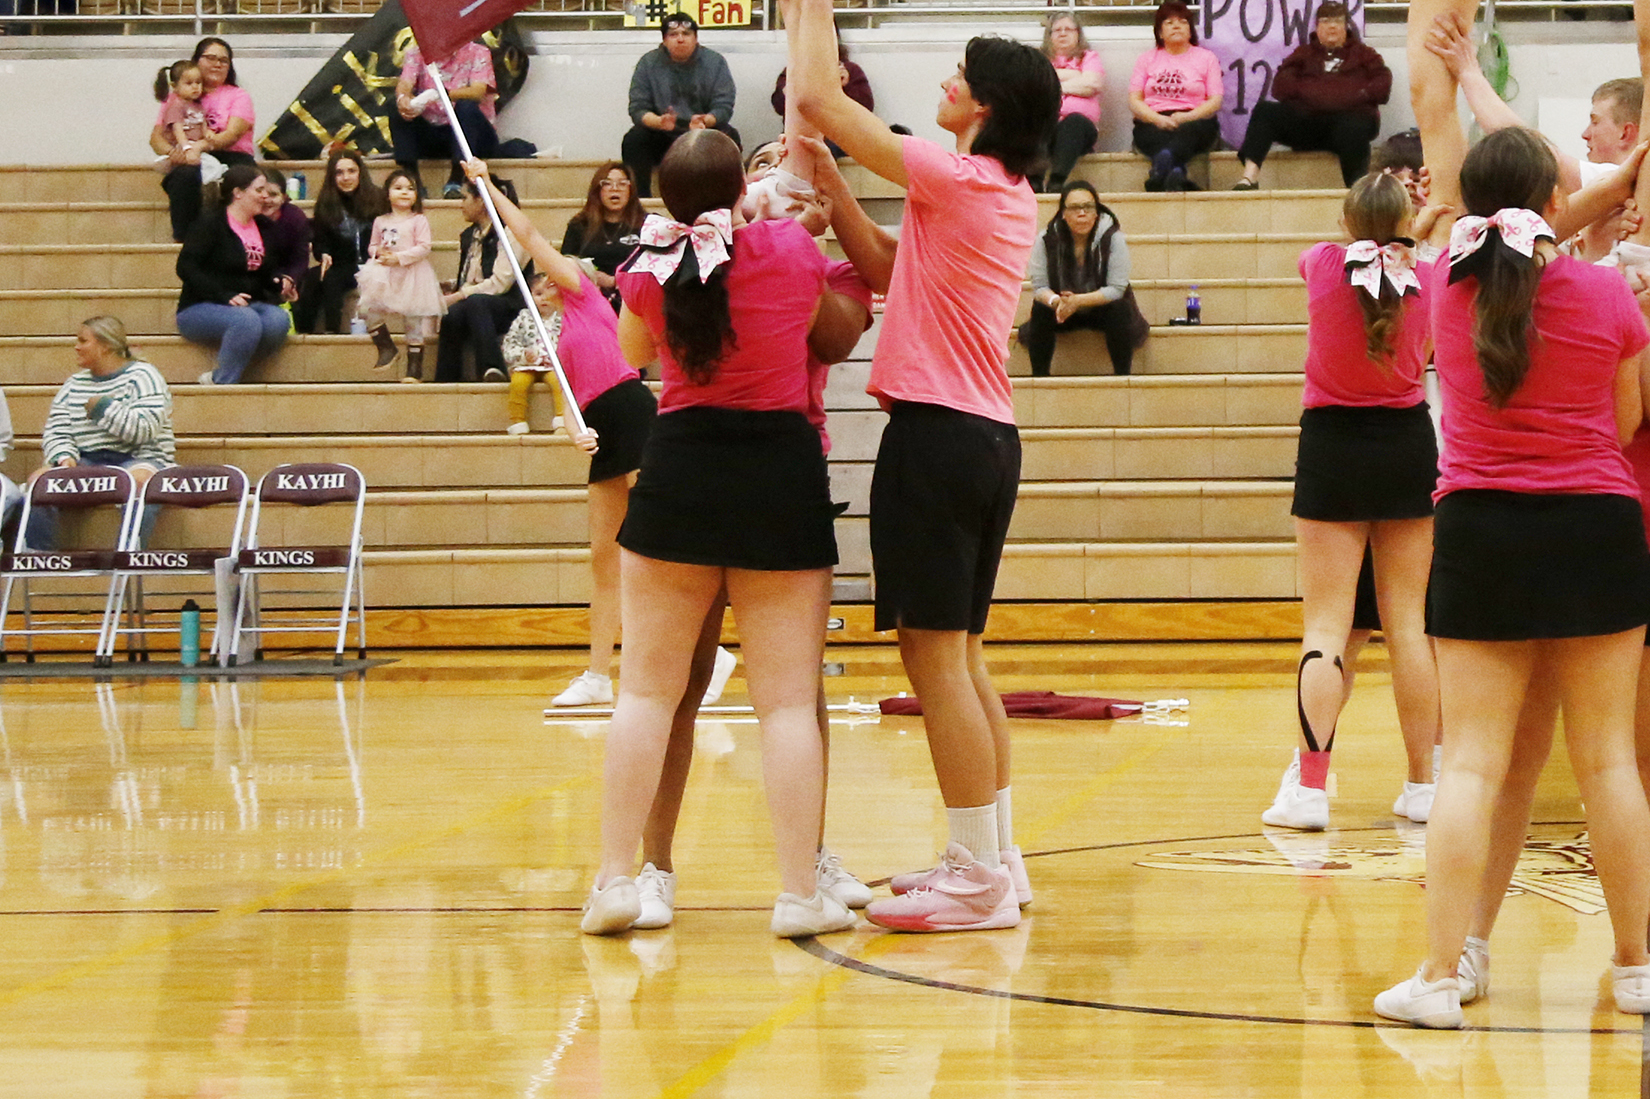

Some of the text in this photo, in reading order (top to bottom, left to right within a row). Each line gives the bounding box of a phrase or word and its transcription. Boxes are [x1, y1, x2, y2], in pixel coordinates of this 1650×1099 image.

[1218, 57, 1274, 115] 12
[46, 476, 118, 494] KAYHI
[160, 475, 229, 493] KAYHI
[277, 473, 346, 491] KAYHI
[12, 555, 72, 571] KINGS
[128, 553, 189, 568] KINGS
[254, 551, 315, 566] KINGS
